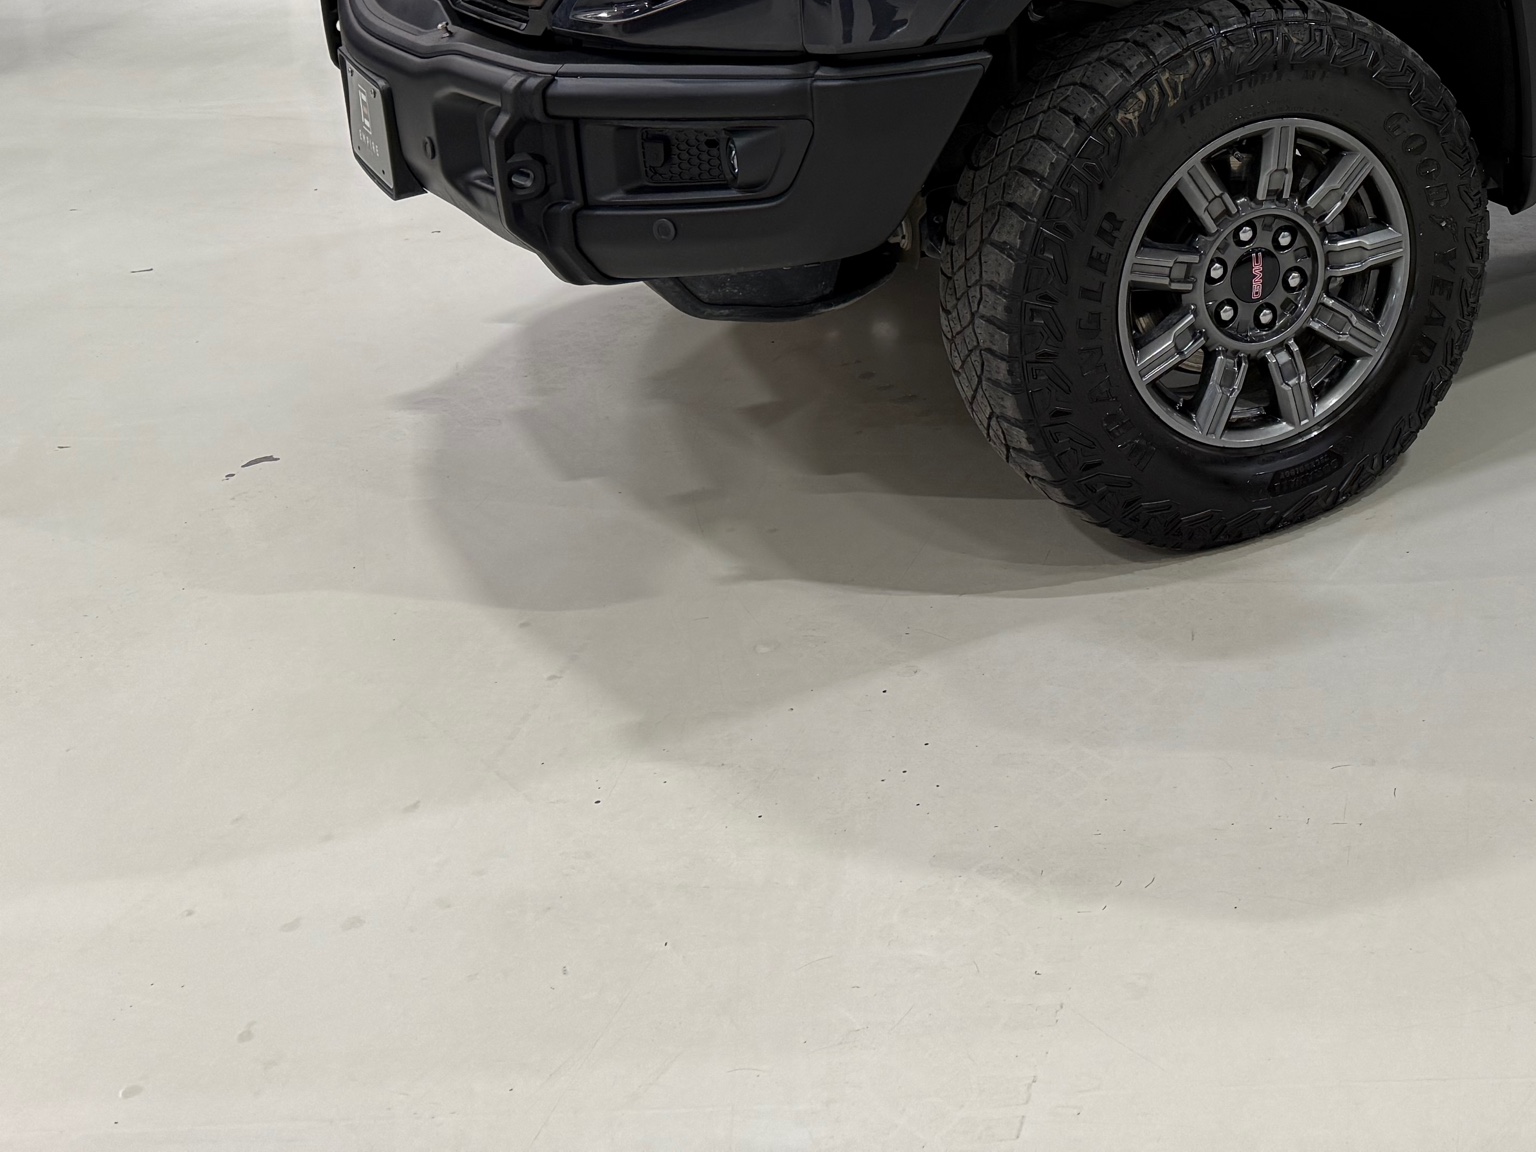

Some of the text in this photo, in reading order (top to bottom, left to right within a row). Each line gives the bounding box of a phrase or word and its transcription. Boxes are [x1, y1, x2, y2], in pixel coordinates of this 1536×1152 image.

[358, 129, 380, 157] EMPIRE
[1251, 252, 1263, 300] GMC
[1077, 211, 1157, 472] WRANGLER
